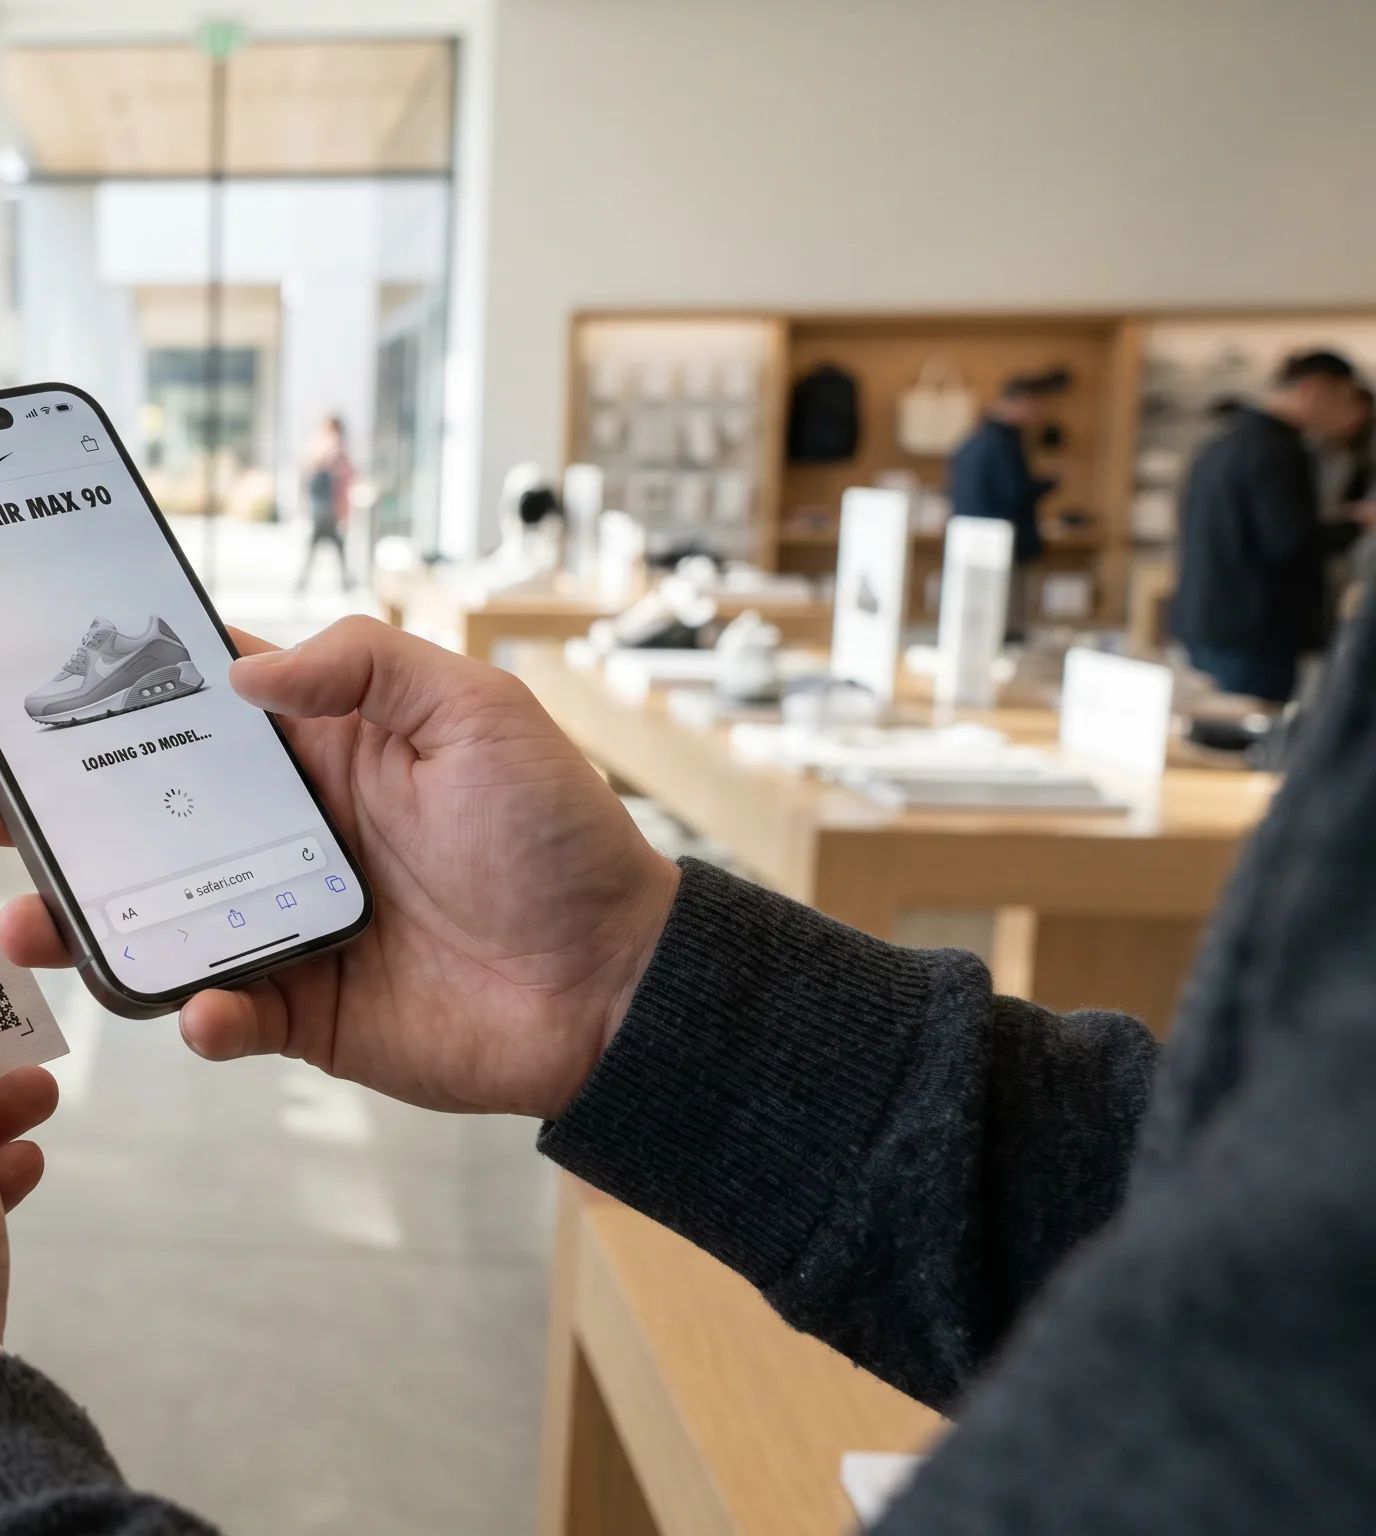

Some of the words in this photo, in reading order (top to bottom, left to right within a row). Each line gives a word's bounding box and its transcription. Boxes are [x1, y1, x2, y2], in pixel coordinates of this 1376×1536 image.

[25, 490, 81, 519] MAX
[81, 485, 112, 508] 90
[81, 746, 138, 772] LOADING
[138, 741, 157, 756] 3D
[157, 729, 213, 751] MODEL...
[196, 869, 255, 897] safari.com
